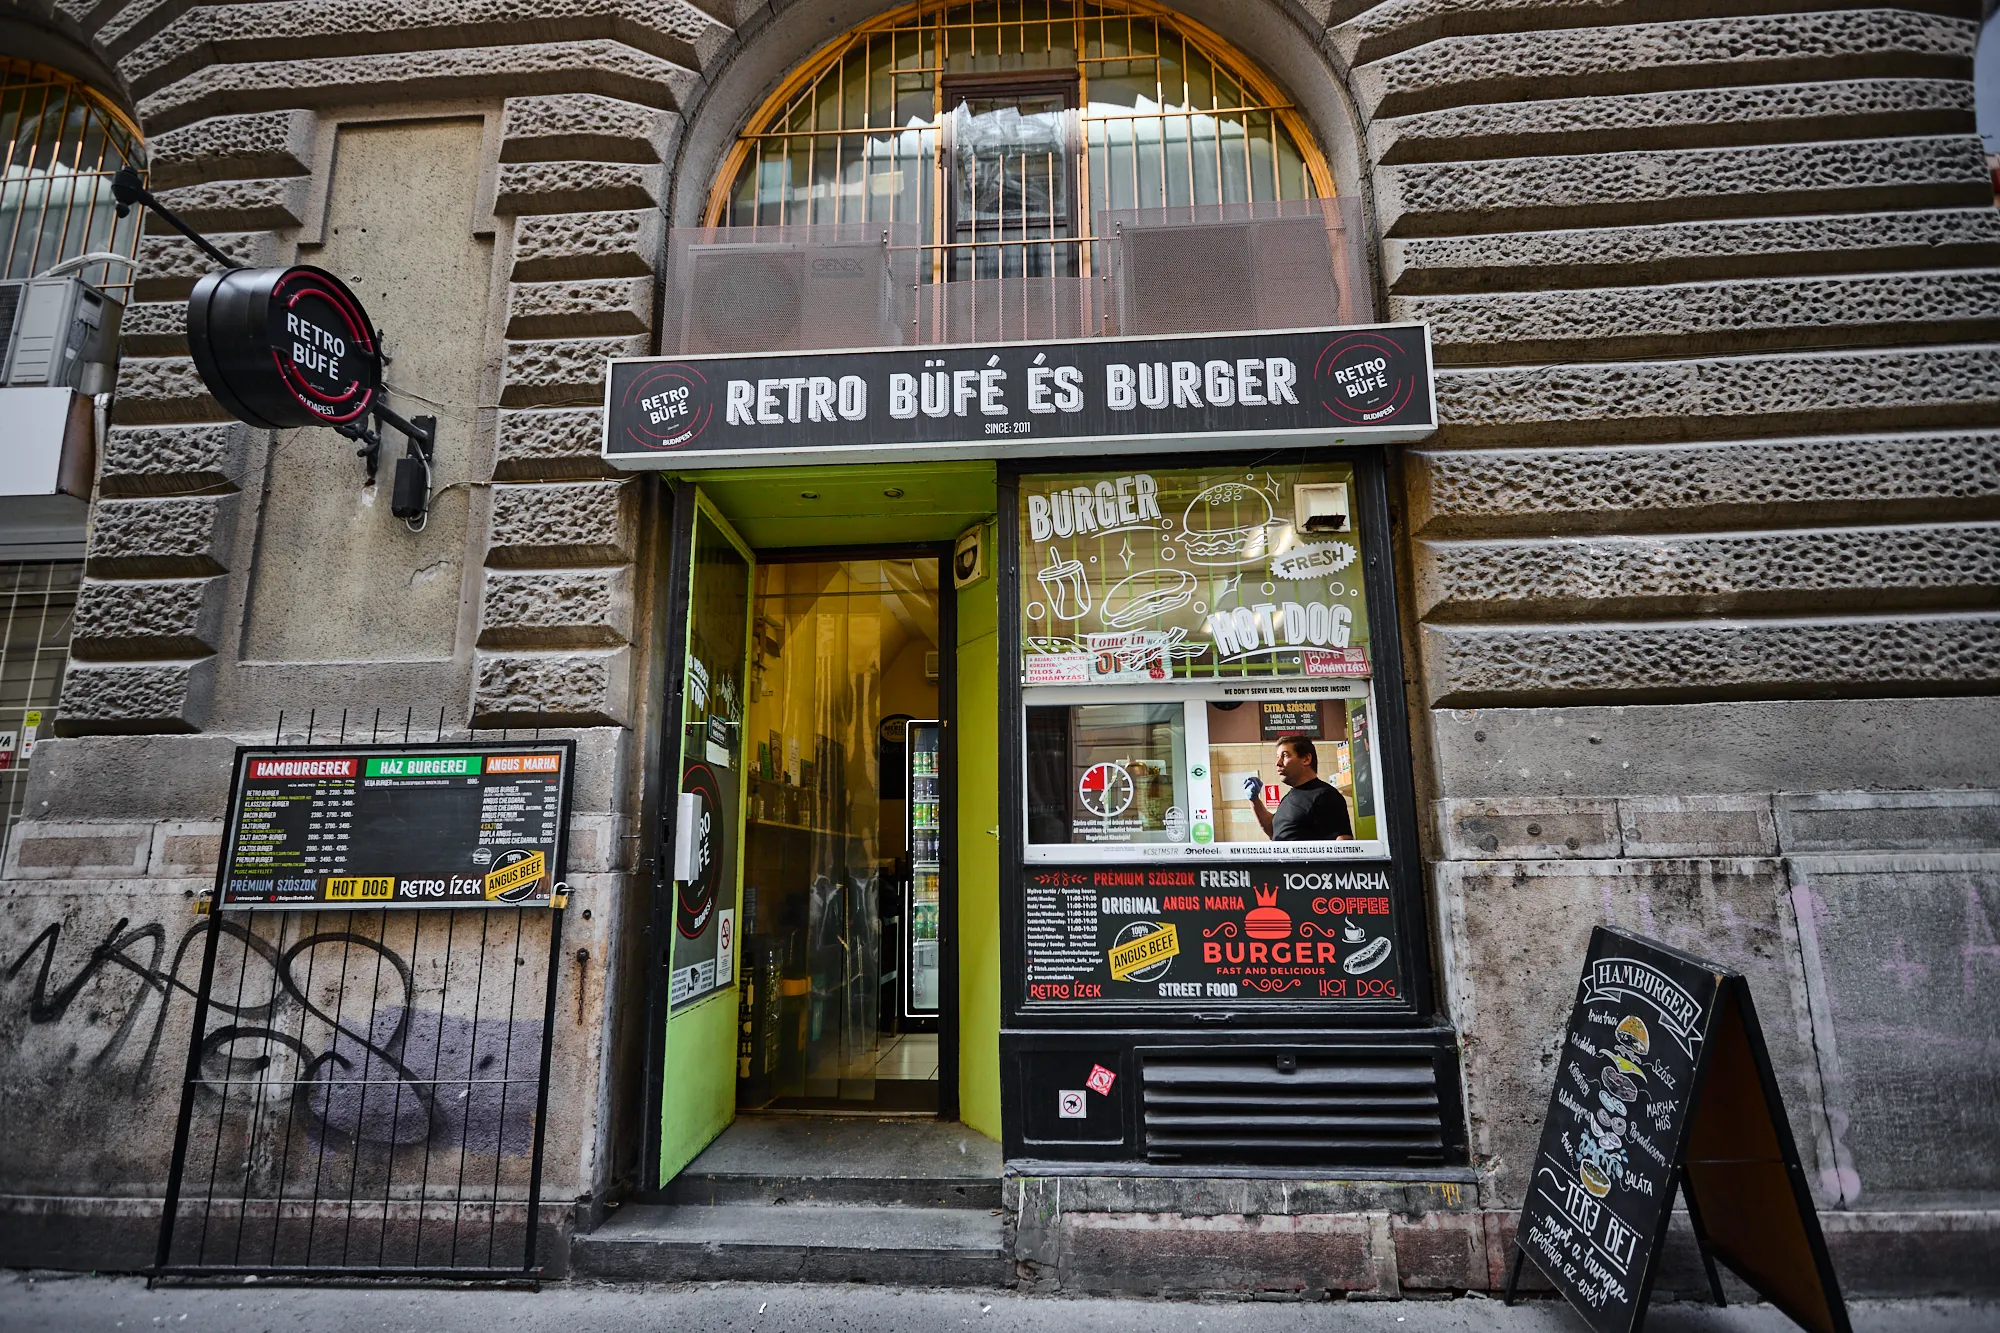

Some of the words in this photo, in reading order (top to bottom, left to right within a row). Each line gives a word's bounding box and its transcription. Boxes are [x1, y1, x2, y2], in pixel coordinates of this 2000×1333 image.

[287, 312, 345, 358] RETRO
[292, 341, 339, 381] BÜFÉ
[1334, 357, 1386, 385] RETRO
[726, 375, 867, 426] RETRO
[889, 354, 1008, 420] BÜFÉ
[1027, 351, 1084, 414] ÉS
[1106, 357, 1299, 412] BURGER
[1345, 371, 1388, 398] BÜFÉ
[641, 386, 689, 412] RETRO
[650, 399, 689, 425] BÜFÉ
[1363, 404, 1396, 421] BUDAPEST
[984, 422, 1012, 434] SINCE:
[1013, 421, 1030, 433] 2011
[662, 430, 693, 446] BUDAPEST
[1028, 474, 1162, 542] BURGER
[1280, 546, 1345, 574] FRESH
[1207, 603, 1277, 657] HOT
[1282, 601, 1353, 649] DOG
[1131, 633, 1145, 646] in
[1233, 687, 1250, 695] DON'T
[1264, 703, 1286, 713] EXTRA
[1286, 701, 1316, 713] SZÓSZOK
[256, 761, 351, 777] HAMBURGEREK
[380, 759, 404, 774] HÁZ
[407, 759, 467, 774] BURGEREI
[488, 759, 520, 771] ANGUS
[523, 757, 556, 770] MARHA
[507, 853, 521, 862] 100%
[229, 875, 274, 892] PRÉMIUM
[276, 875, 318, 892] SZÓSZOK
[488, 869, 518, 891] ANGUS
[520, 859, 541, 878] BEEF
[1093, 869, 1144, 886] PRÉMIUM
[1148, 868, 1195, 886] SZÓSZOK
[1200, 870, 1251, 887] FRESH
[1335, 871, 1390, 890] MARHA
[332, 880, 358, 896] HOT
[362, 878, 388, 896] DOG
[400, 879, 445, 898] RETRO
[449, 874, 483, 895] ÍZEK
[1101, 896, 1161, 914] ORIGINAL
[1163, 896, 1200, 910] ANGUS
[1204, 896, 1245, 910] MARHA
[1311, 897, 1390, 915] COFFEE
[1131, 925, 1149, 935] 100%
[1114, 944, 1147, 969] ANGUS
[1149, 933, 1174, 955] BEEF
[1203, 942, 1336, 964] BURGER
[1216, 967, 1242, 975] FAST
[1245, 967, 1267, 975] AND
[1270, 967, 1326, 975] DELICIOUS
[1030, 984, 1070, 999] RETRO
[1073, 980, 1102, 998] ÍZEK
[1158, 982, 1202, 997] STREET
[1206, 982, 1238, 997] FOOD
[1318, 979, 1346, 997] HOT
[1357, 979, 1396, 997] DOG
[1598, 964, 1694, 1029] HAMBURGER
[1651, 1058, 1676, 1090] SZÓSZ
[1655, 1114, 1671, 1131] HÚS
[1624, 1169, 1653, 1197] SALÁTA
[1604, 1216, 1636, 1270] BE!
[1564, 1262, 1577, 1283] az
[1572, 1243, 1581, 1260] a
[1584, 1247, 1628, 1303] burger
